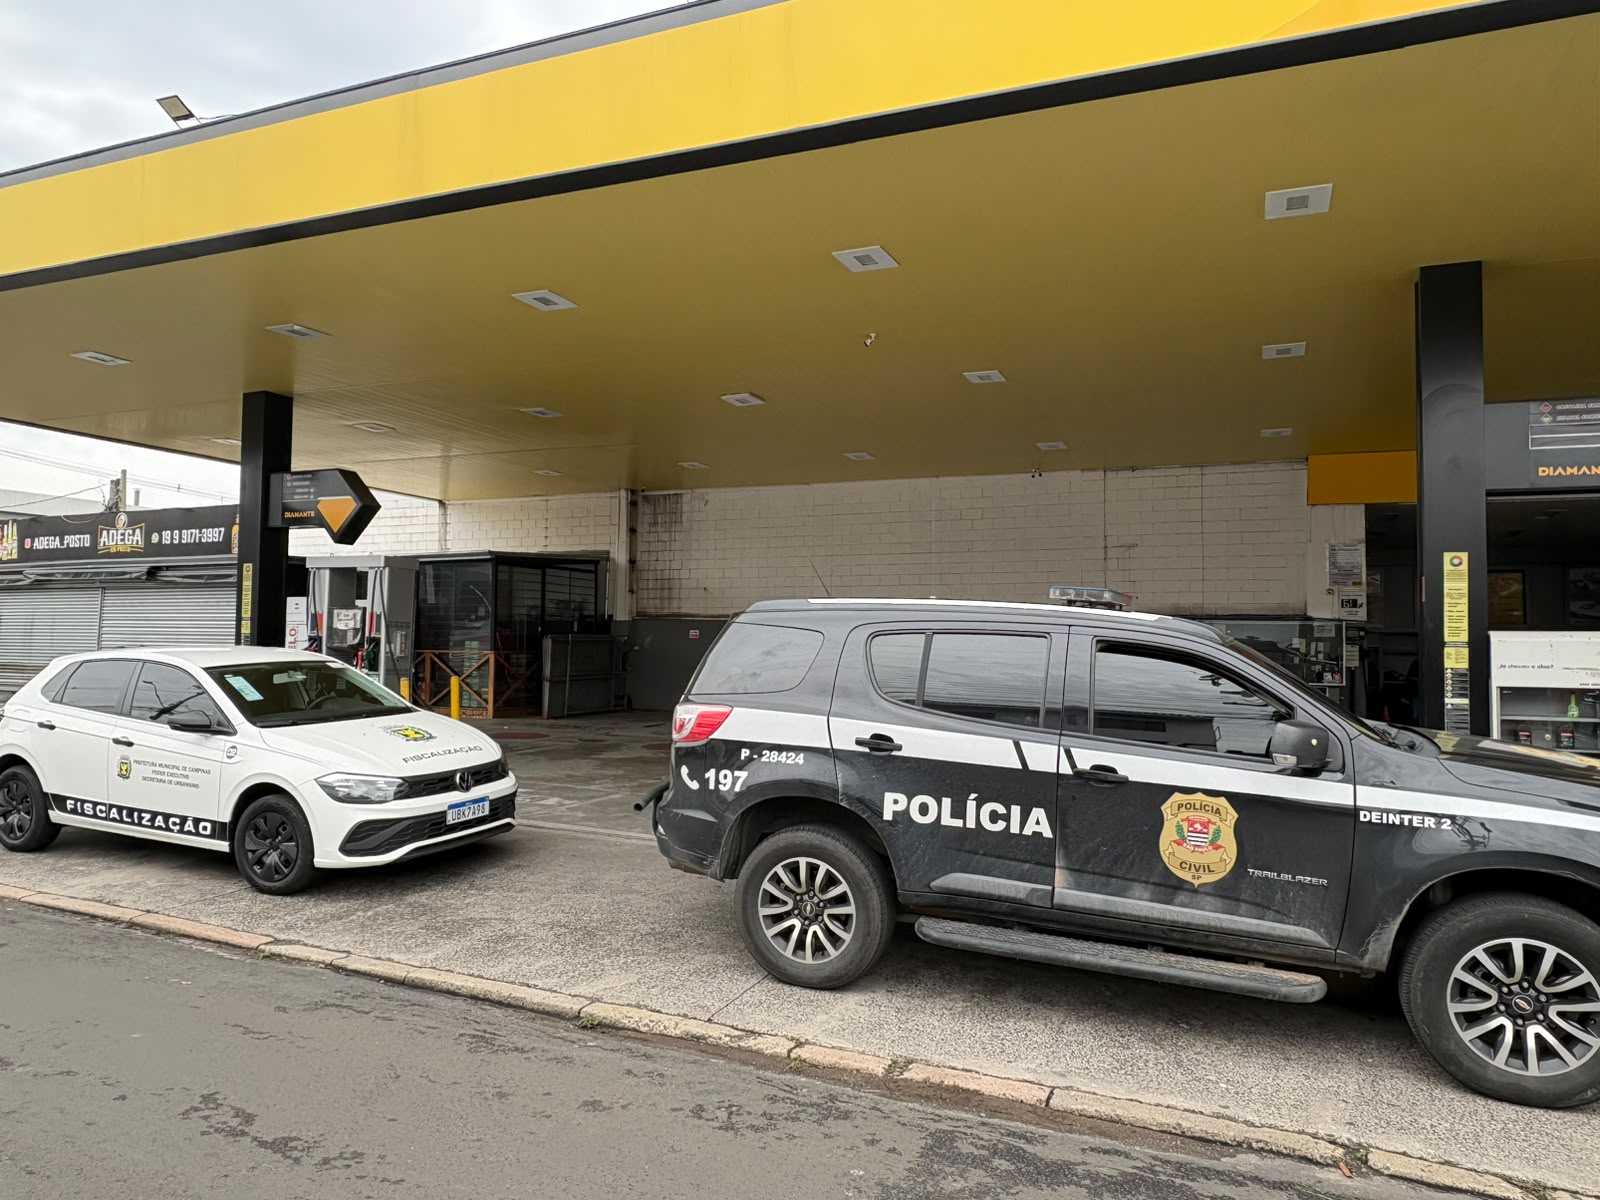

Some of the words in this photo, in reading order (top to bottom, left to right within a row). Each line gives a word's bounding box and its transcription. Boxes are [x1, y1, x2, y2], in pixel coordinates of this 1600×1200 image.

[1538, 465, 1600, 476] DIAMAN
[33, 534, 90, 549] ADEGA_POSTO
[99, 527, 142, 547] ADEGA
[162, 530, 170, 544] 19
[173, 529, 179, 544] 9
[181, 527, 225, 543] 9171-3997
[402, 745, 483, 764] FISCALIZAÇÃO
[740, 748, 750, 760] P
[761, 750, 804, 765] 28424
[133, 759, 157, 768] PREFEITURA
[158, 762, 180, 771] MUNICIPAL
[188, 766, 211, 775] CAMPINAS
[166, 771, 189, 780] EXECUTIVO
[142, 775, 166, 784] SECRETARIA
[174, 779, 200, 789] URBANISMO
[704, 768, 748, 792] 197
[66, 799, 211, 836] FISCALIZAÇÃO
[882, 791, 1053, 839] POLÍCIA
[1177, 802, 1222, 816] POLÍCIA
[1359, 810, 1436, 829] DEINTER
[1440, 818, 1451, 830] 2
[1179, 861, 1215, 873] CIVIL
[1247, 868, 1328, 887] TRAILBLAZER
